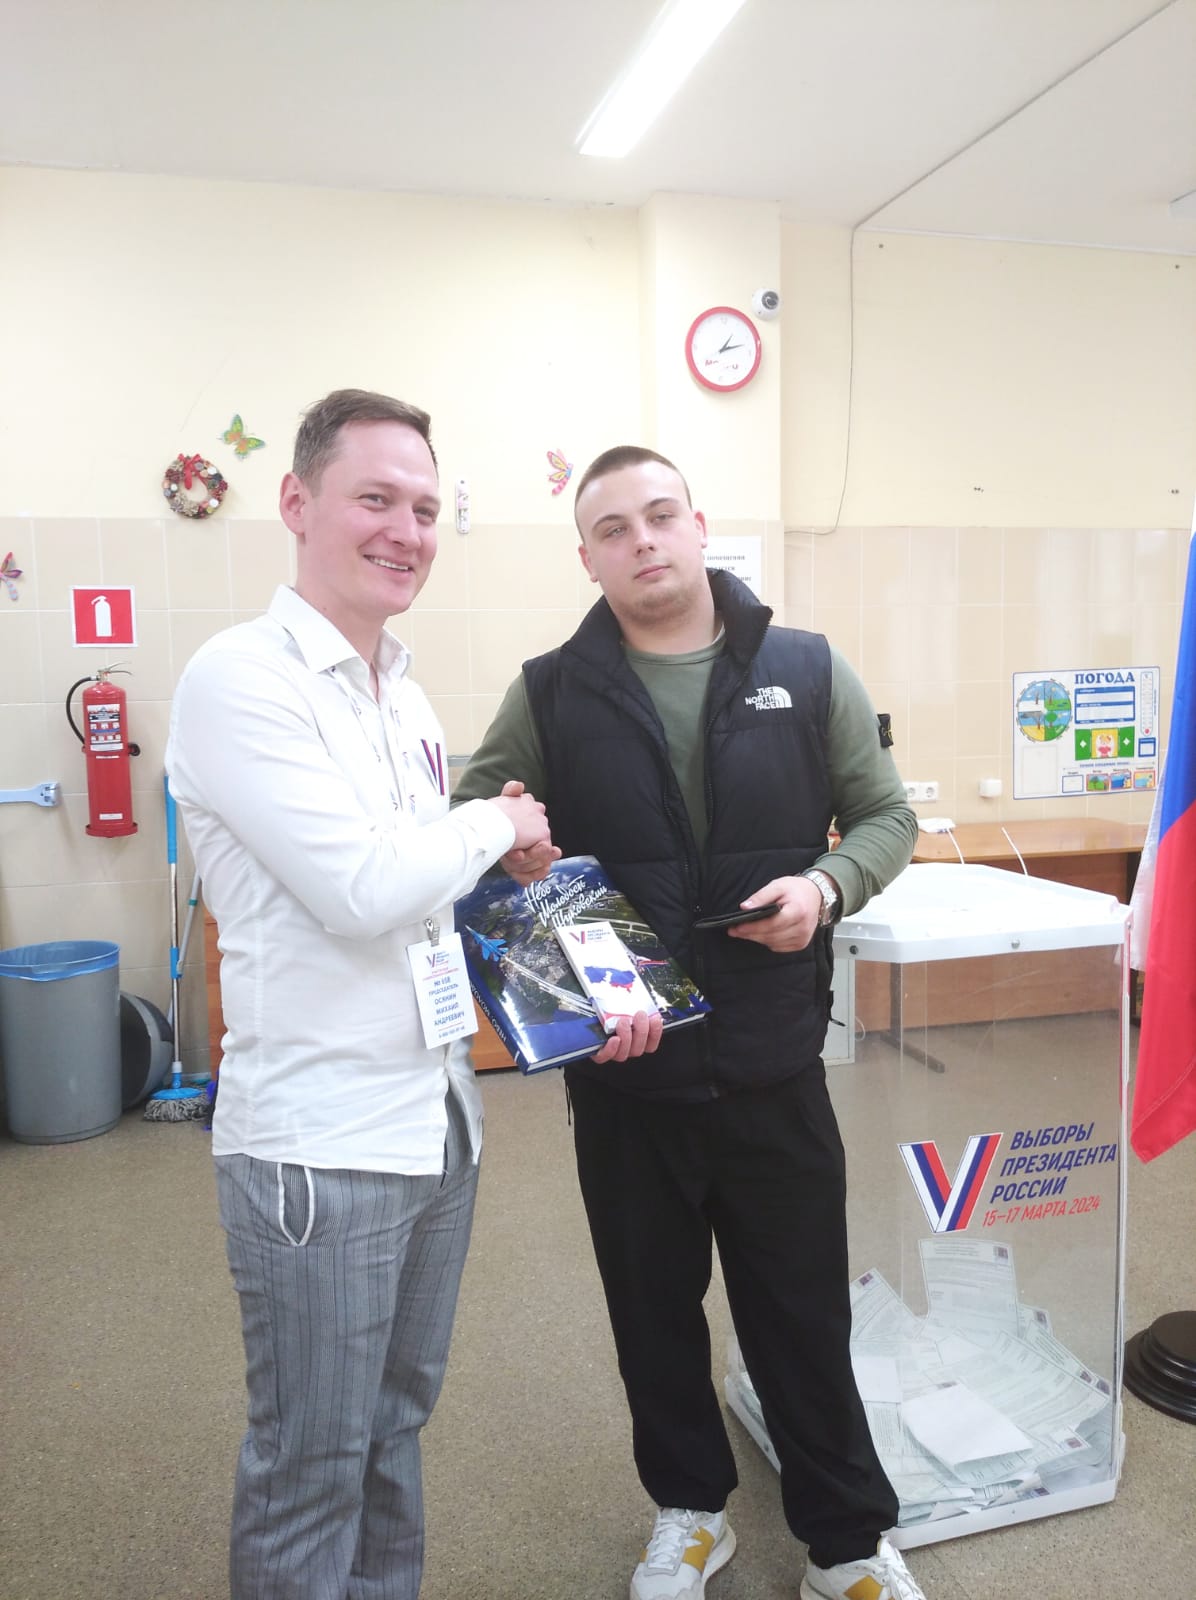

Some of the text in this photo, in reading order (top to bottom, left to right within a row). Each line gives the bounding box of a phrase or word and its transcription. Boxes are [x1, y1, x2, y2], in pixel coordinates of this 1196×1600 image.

[1074, 671, 1136, 685] ПОГОДА
[745, 695, 775, 705] NORTH
[756, 687, 774, 696] THE
[755, 702, 777, 711] FACE
[523, 872, 555, 914] Небо
[434, 1011, 465, 1026] АНДРЕЕВИЧ
[1010, 1122, 1095, 1151] ВЫБОРЫ
[1000, 1143, 1118, 1177] ПРЕЗИДЕНТА
[990, 1176, 1068, 1204] РОССИИ
[1020, 1203, 1066, 1222] МАРТА
[1068, 1195, 1101, 1215] 2024
